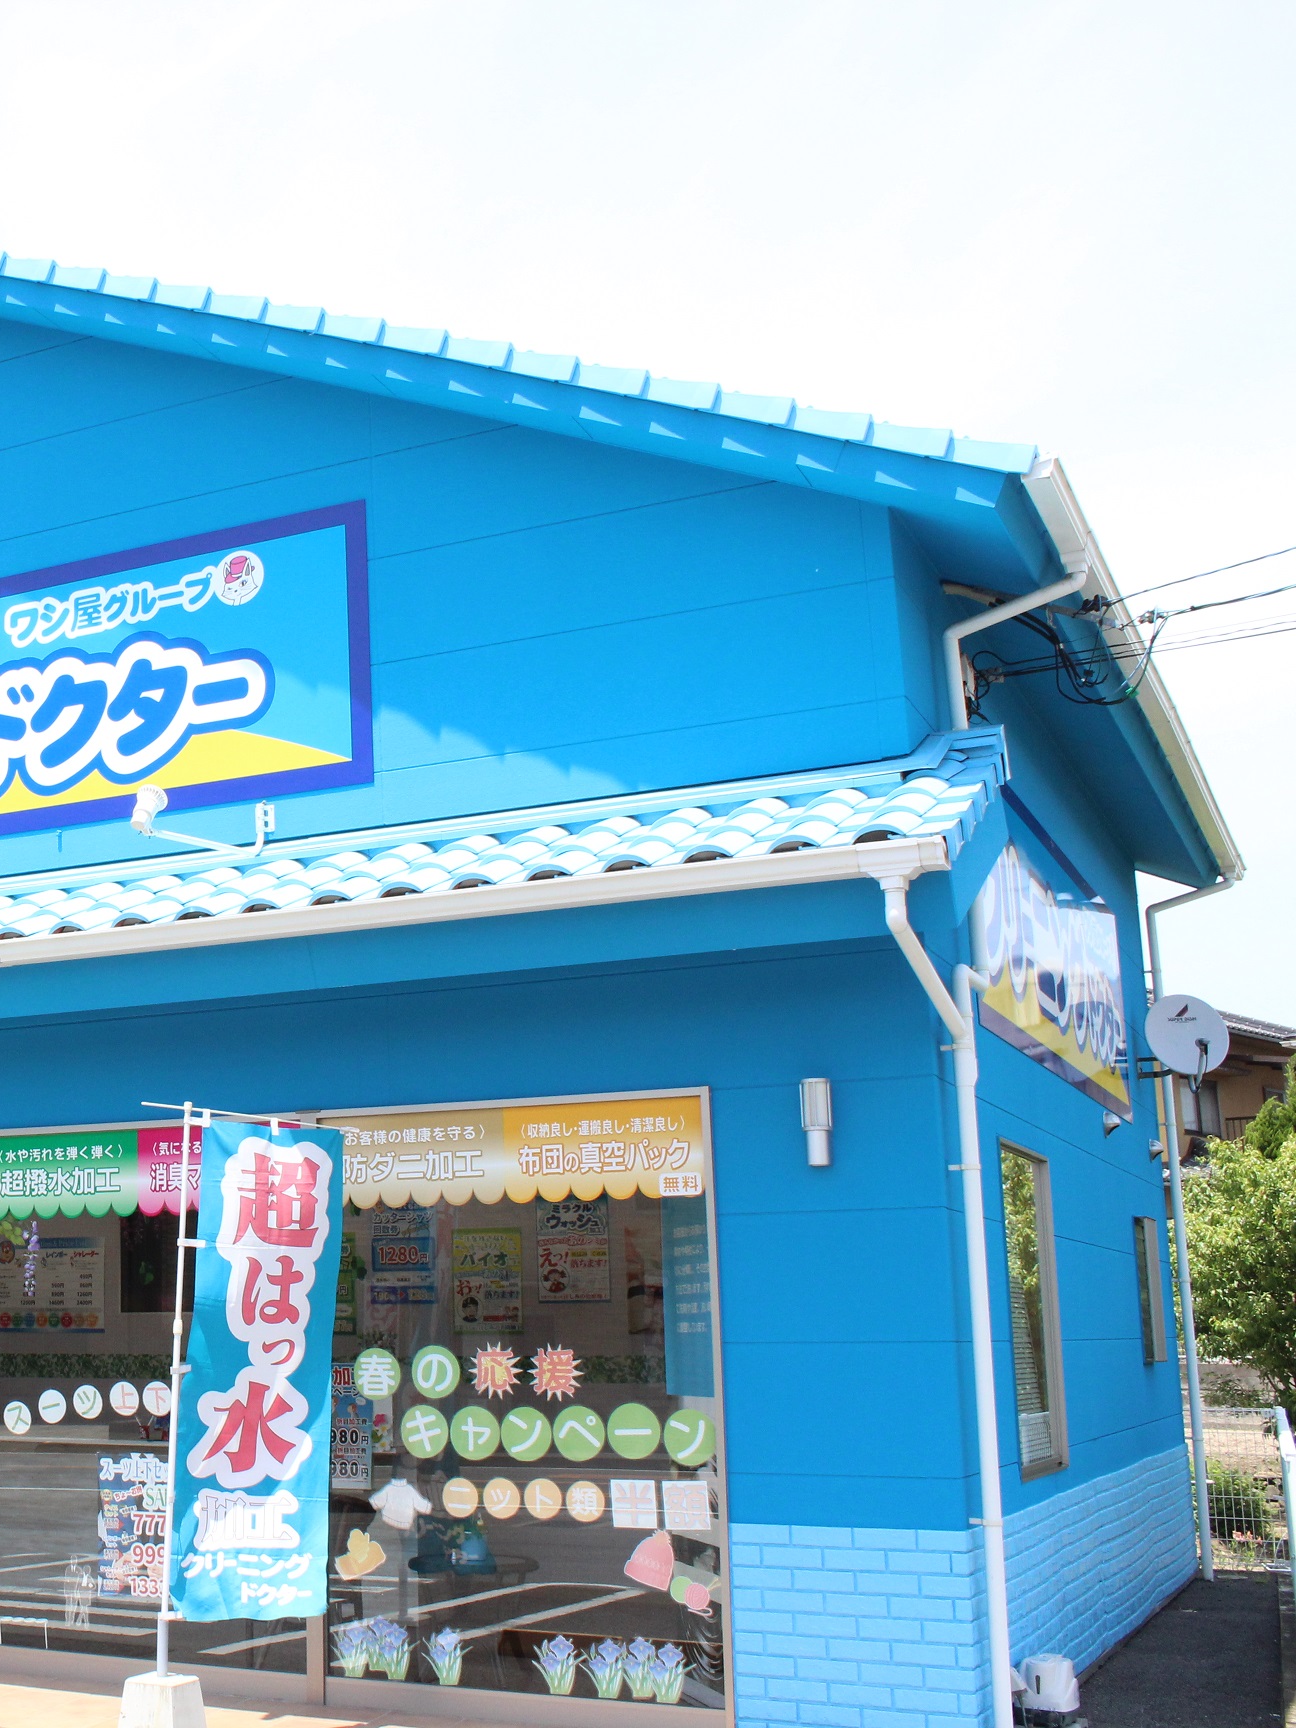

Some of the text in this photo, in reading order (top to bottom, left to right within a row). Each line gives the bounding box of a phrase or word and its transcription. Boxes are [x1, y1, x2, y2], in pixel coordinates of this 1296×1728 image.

[7, 569, 214, 646] ワシ屋グループ
[342, 1148, 484, 1184] 防ダニ加工
[518, 1138, 690, 1177] 布団の真空パック
[0, 1166, 121, 1196] 超撥水加工
[662, 1174, 699, 1193] 無料
[460, 1251, 508, 1267] バイオ
[357, 1348, 576, 1395] 春の応援
[6, 1384, 170, 1431] スーツ上下
[406, 1410, 705, 1459] キャンペーン
[201, 1495, 293, 1543] 加工
[181, 1551, 313, 1579] クリーニング
[241, 1581, 313, 1606] ドクター
